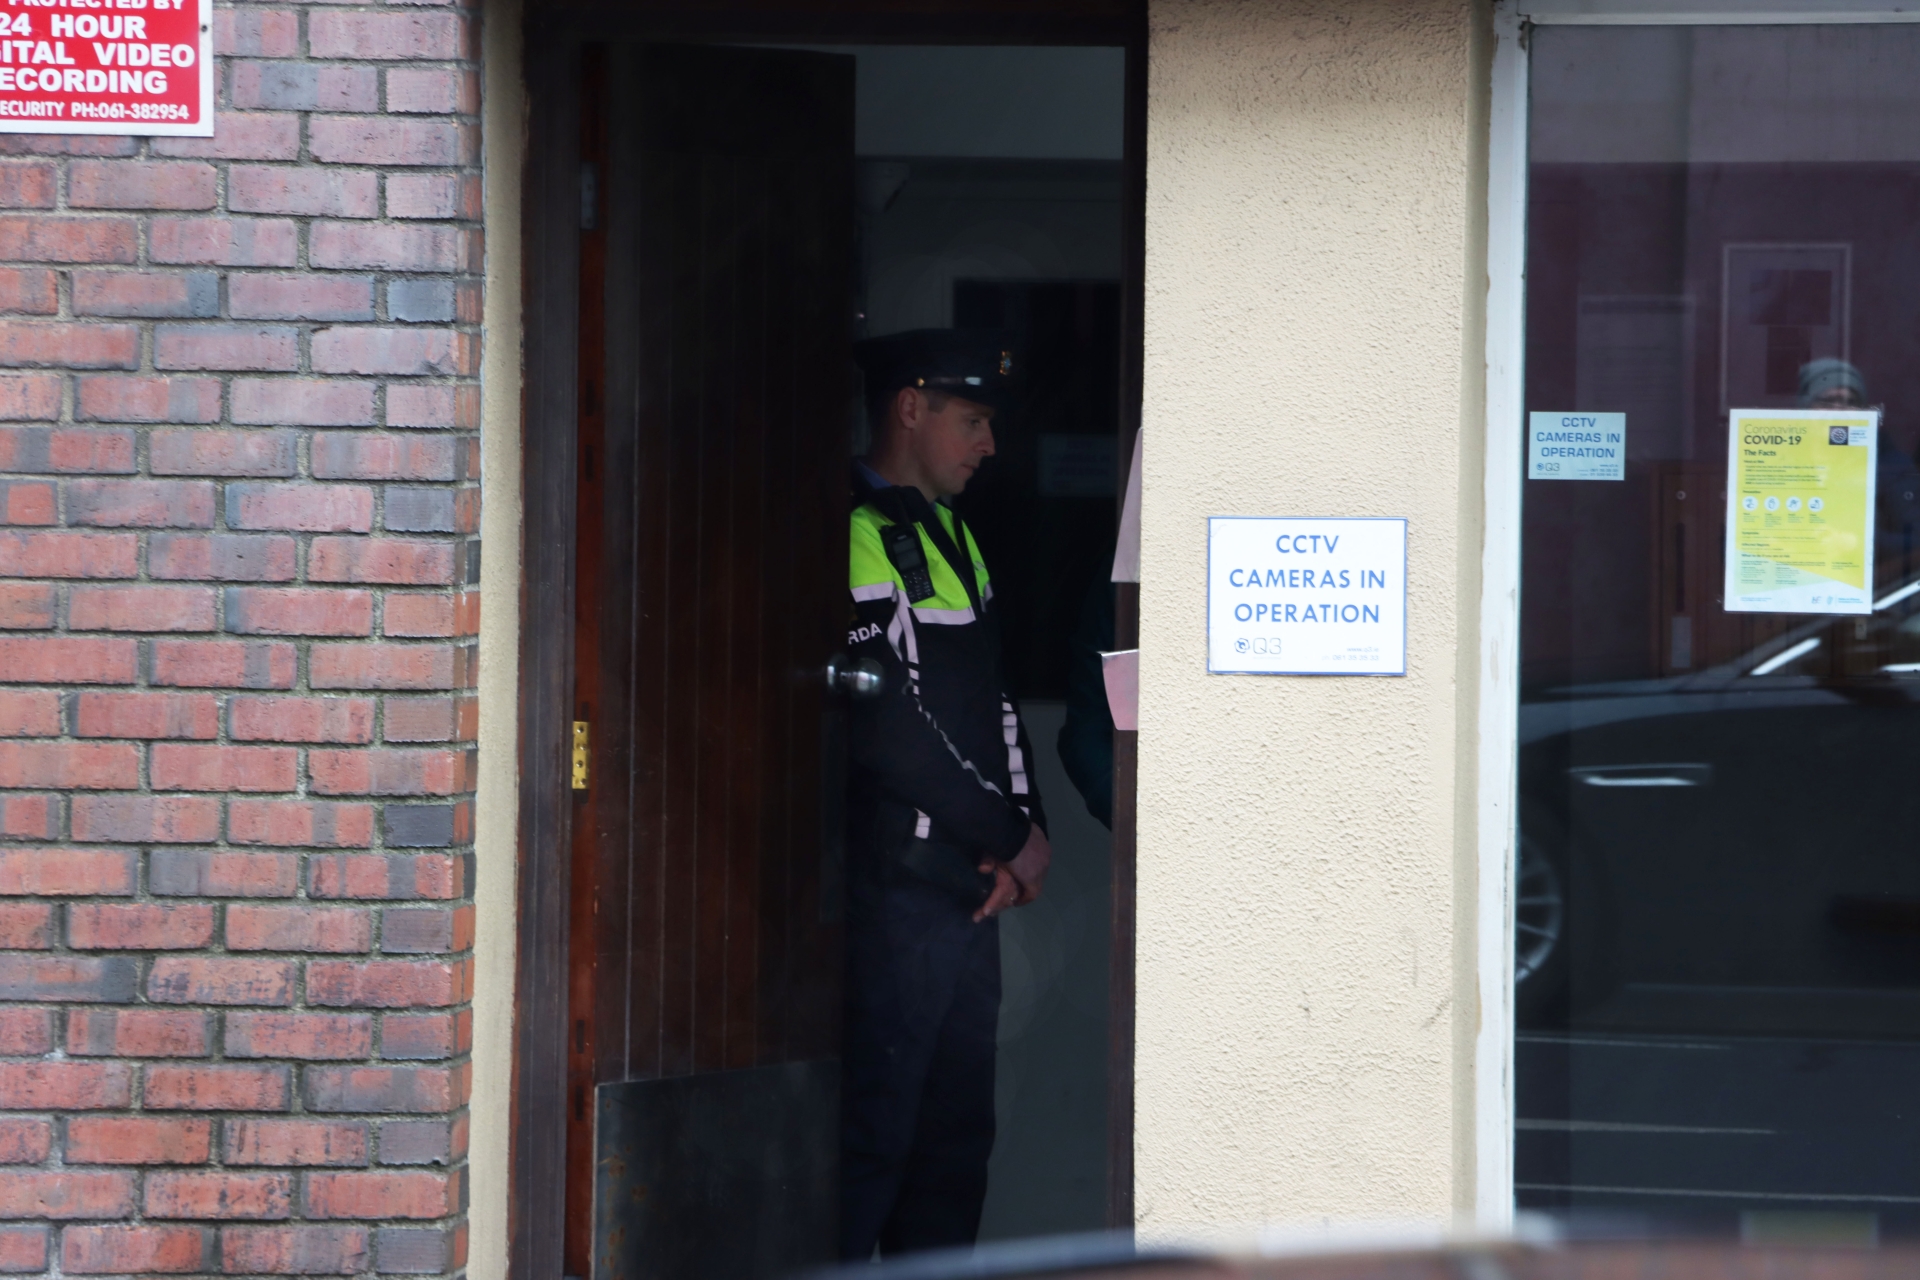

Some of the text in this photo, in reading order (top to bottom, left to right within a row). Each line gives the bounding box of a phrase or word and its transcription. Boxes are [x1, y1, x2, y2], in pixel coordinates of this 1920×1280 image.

[0, 12, 147, 39] 24 HOUR
[0, 40, 195, 67] ITAL VIDEO
[71, 102, 189, 120] PH:061-382954
[1561, 417, 1597, 428] CCTV
[1744, 424, 1807, 434] Coronavirus
[1536, 432, 1621, 443] CAMERAS IN
[1744, 435, 1802, 445] COVID-19
[1541, 447, 1615, 458] OPERATION
[1275, 534, 1340, 554] CCTV
[1229, 568, 1386, 589] CAMERAS IN
[1234, 603, 1380, 623] OPERATION
[1252, 637, 1283, 655] Q3
